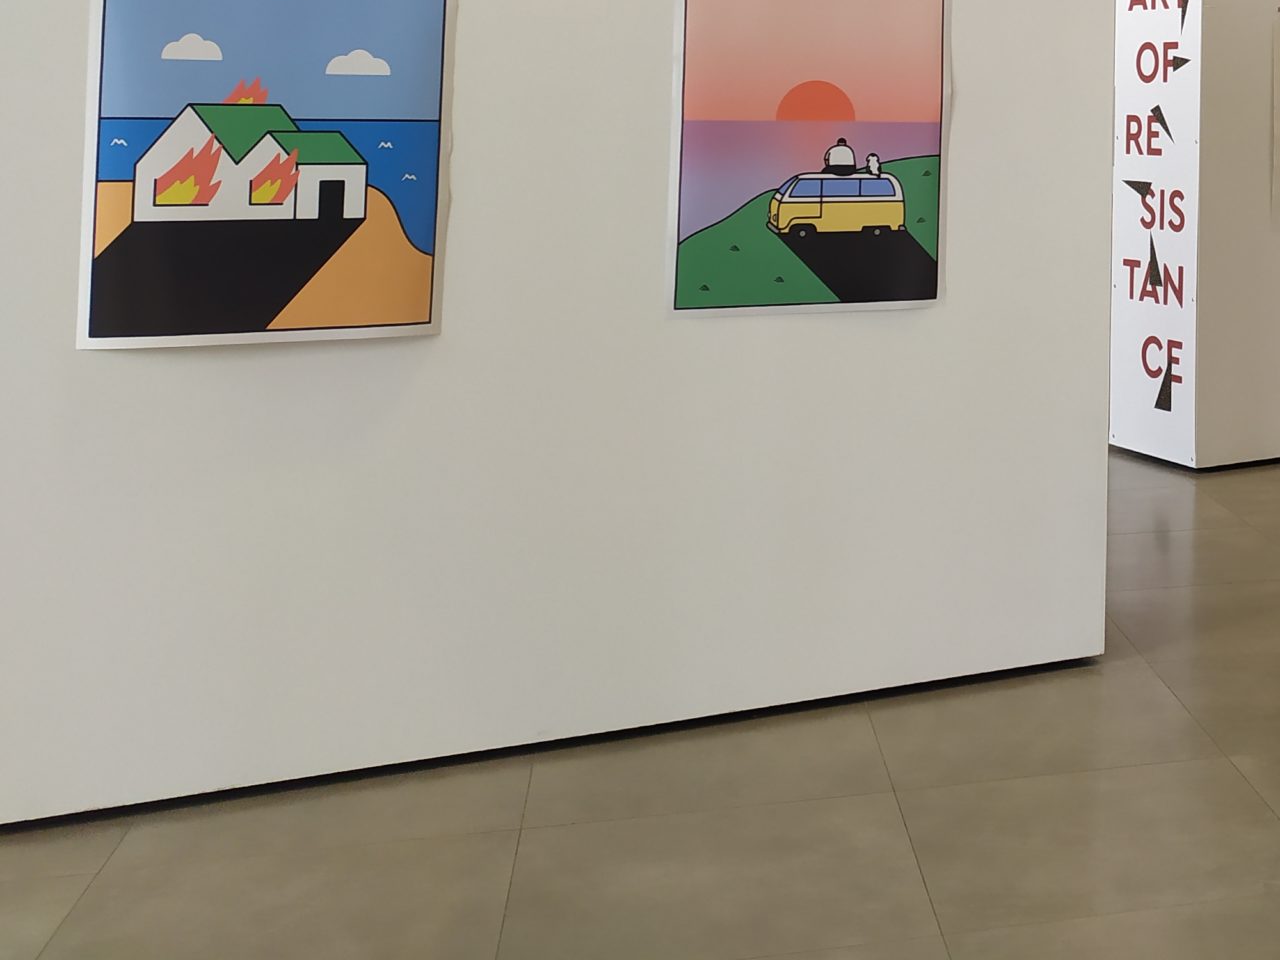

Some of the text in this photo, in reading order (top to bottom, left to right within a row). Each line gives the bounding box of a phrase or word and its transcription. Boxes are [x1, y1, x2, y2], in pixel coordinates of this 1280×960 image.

[1136, 41, 1179, 83] OF
[1125, 114, 1163, 156] RE
[1140, 189, 1185, 233] SIS
[1122, 257, 1184, 309] TAN
[1141, 335, 1183, 384] CE
